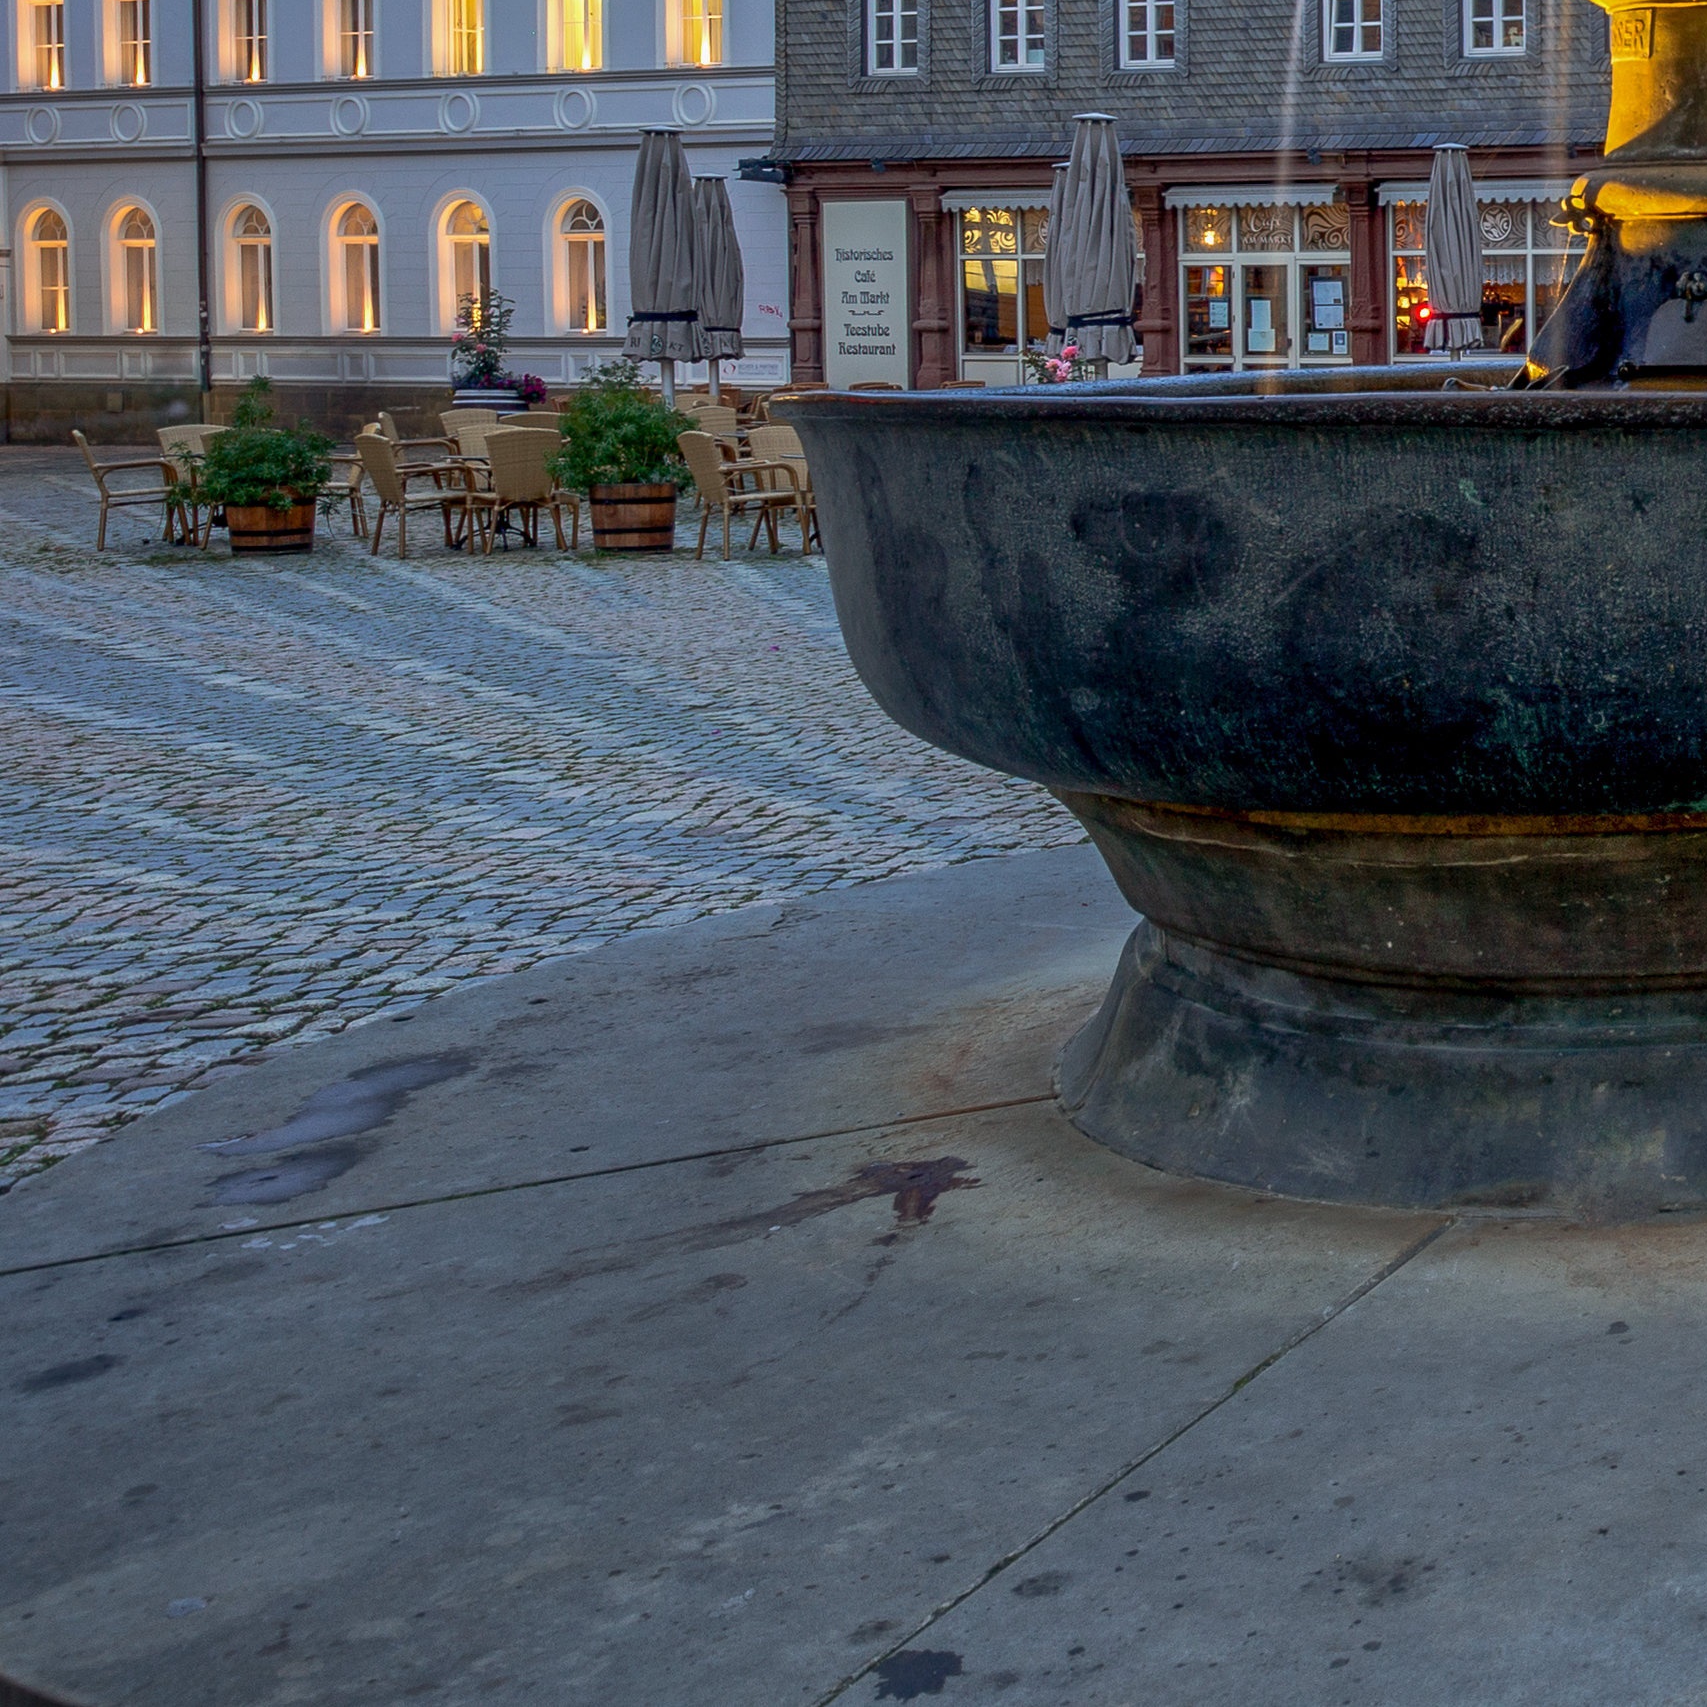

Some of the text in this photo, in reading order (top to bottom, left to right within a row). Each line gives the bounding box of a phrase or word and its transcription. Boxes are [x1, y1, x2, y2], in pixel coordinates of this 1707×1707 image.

[835, 247, 893, 262] Historisches
[854, 270, 876, 283] Café
[841, 291, 890, 304] Am Markt
[843, 323, 890, 337] Teestube
[838, 342, 896, 355] Restaurant
